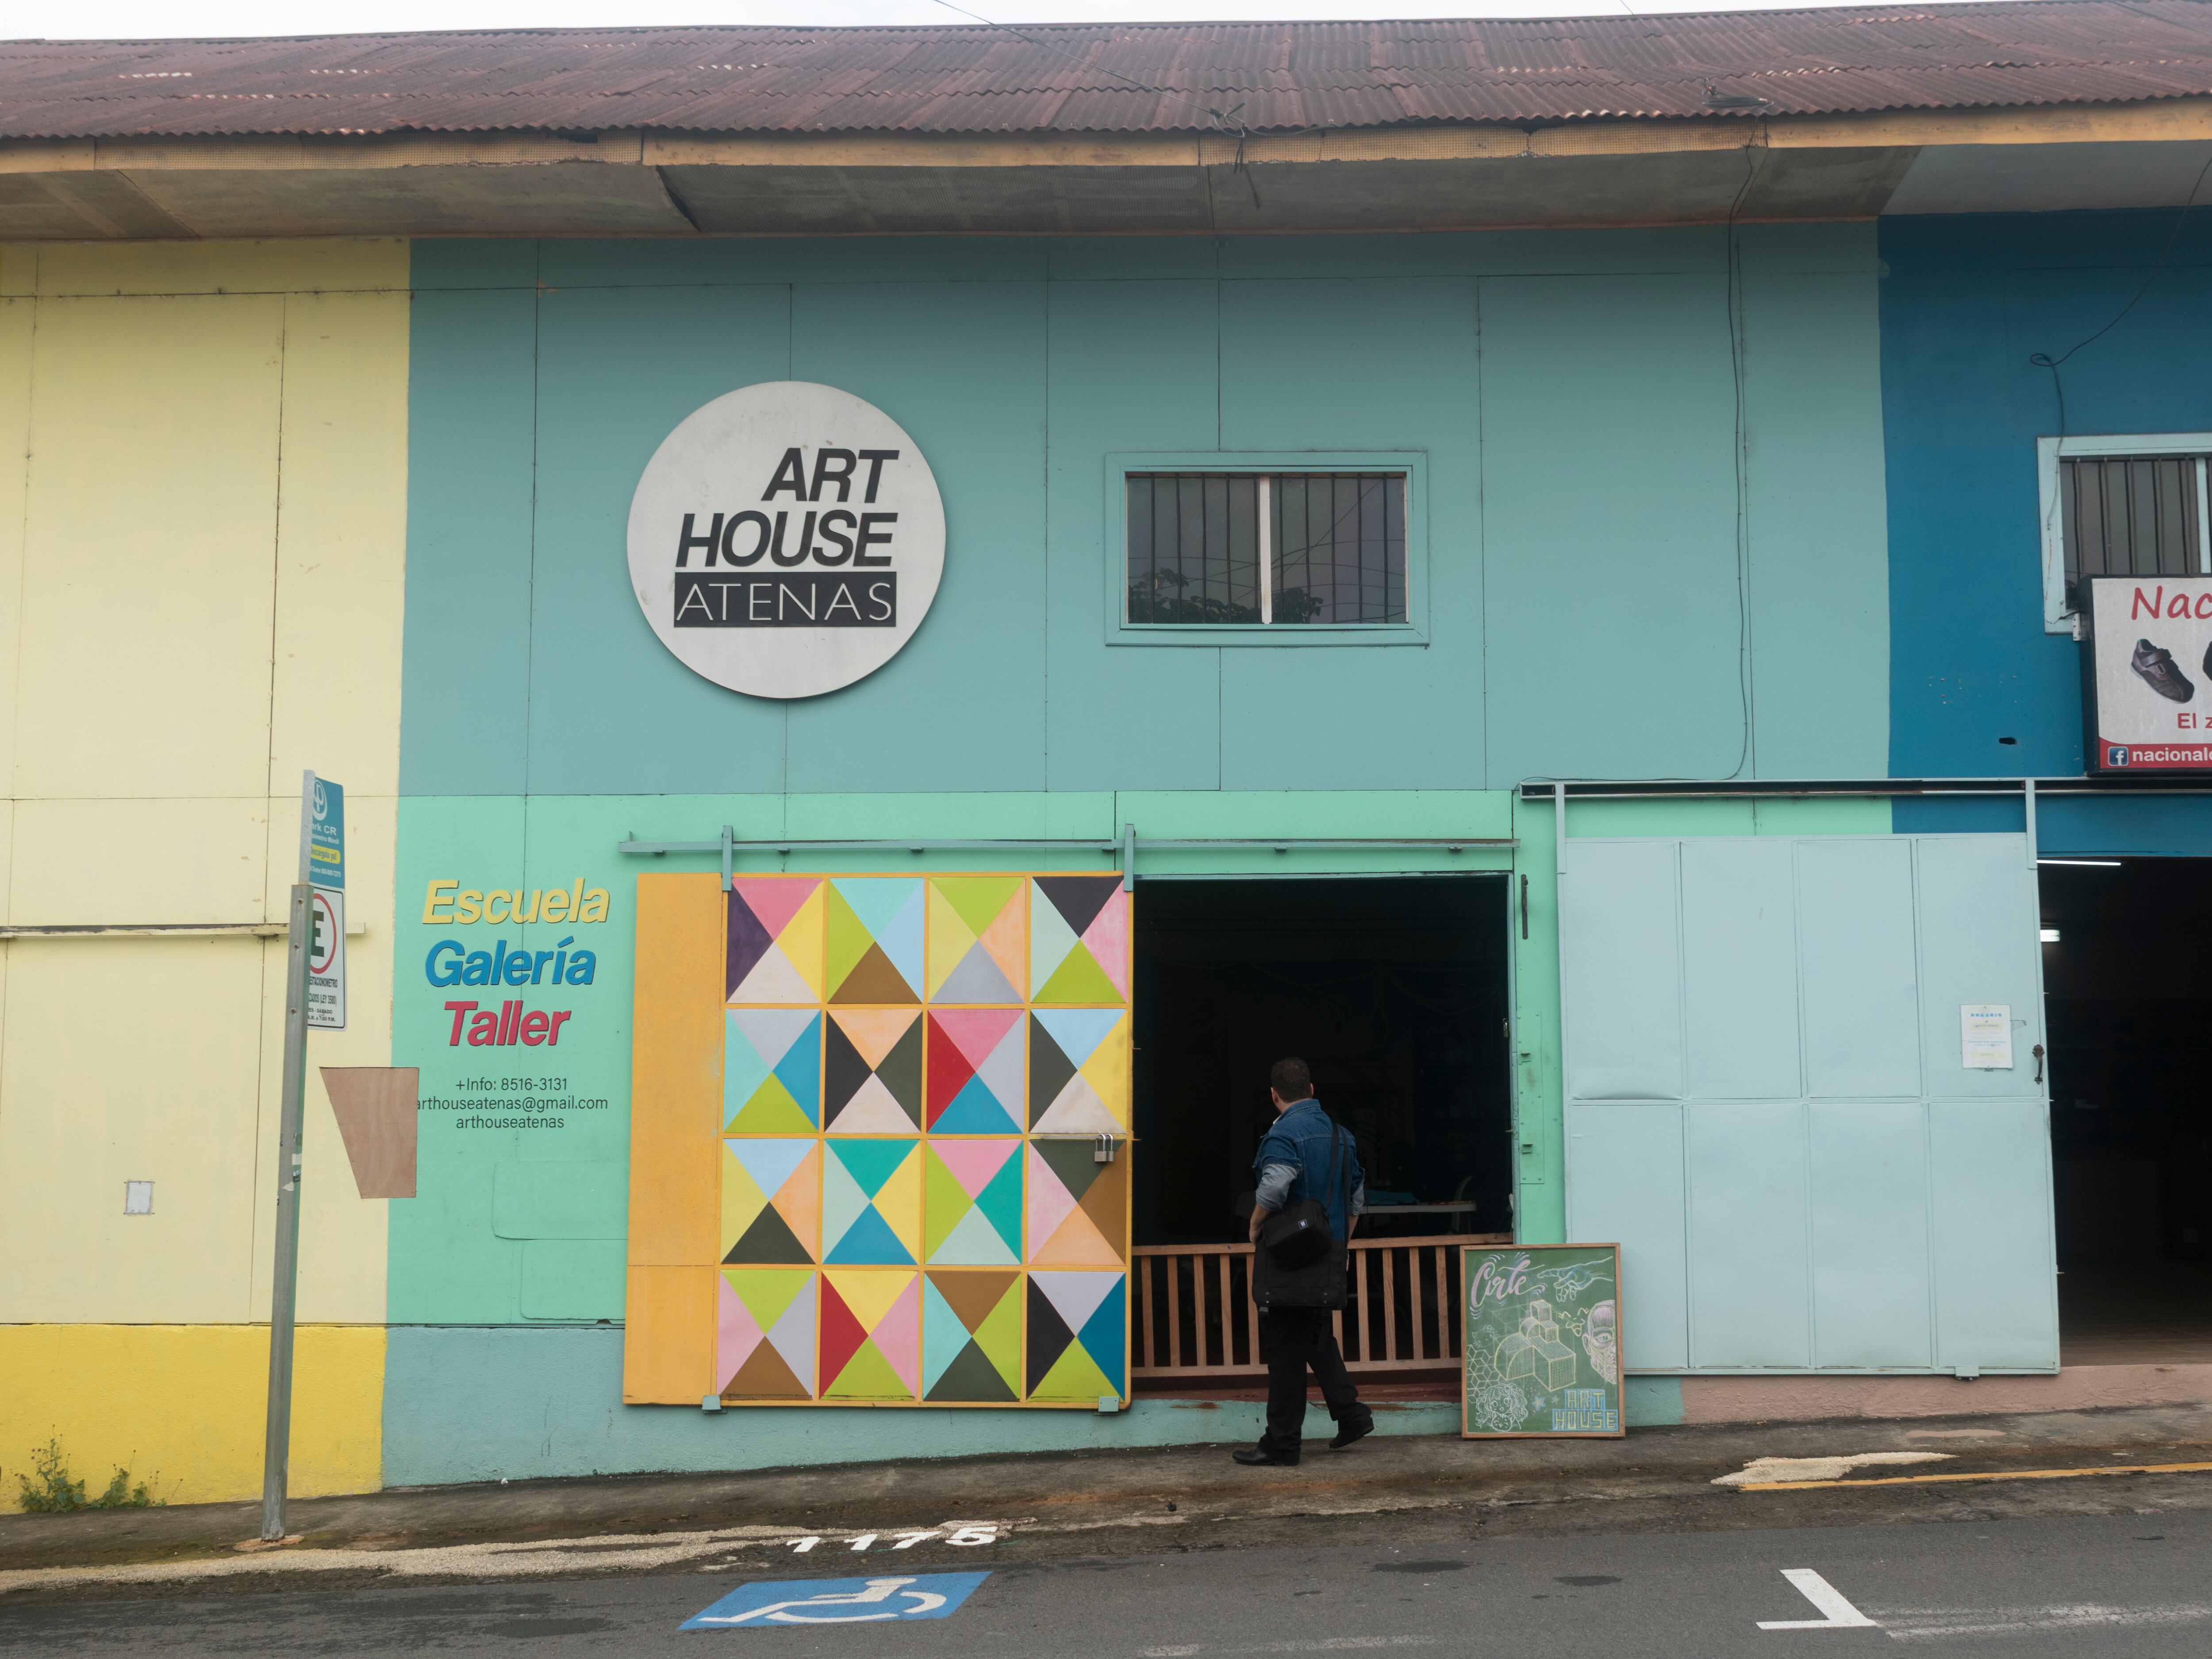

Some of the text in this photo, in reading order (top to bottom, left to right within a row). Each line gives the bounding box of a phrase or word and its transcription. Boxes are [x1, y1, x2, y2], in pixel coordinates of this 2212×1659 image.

[760, 448, 899, 503] ART
[676, 509, 898, 567] HOUSE
[676, 583, 892, 620] ATENAS
[2177, 713, 2197, 729] El
[2133, 747, 2212, 761] nacional
[312, 823, 337, 836] ark CR
[422, 878, 610, 924] Escuela
[311, 910, 324, 957] E
[425, 936, 596, 987] Galería
[309, 993, 319, 1003] ZADOS
[445, 1000, 571, 1046] Taller
[456, 1077, 567, 1091] +Info: 8516-3131
[456, 1115, 564, 1129] arthouseatenas
[1567, 1390, 1604, 1409] ART
[1555, 1411, 1616, 1430] HOUSE
